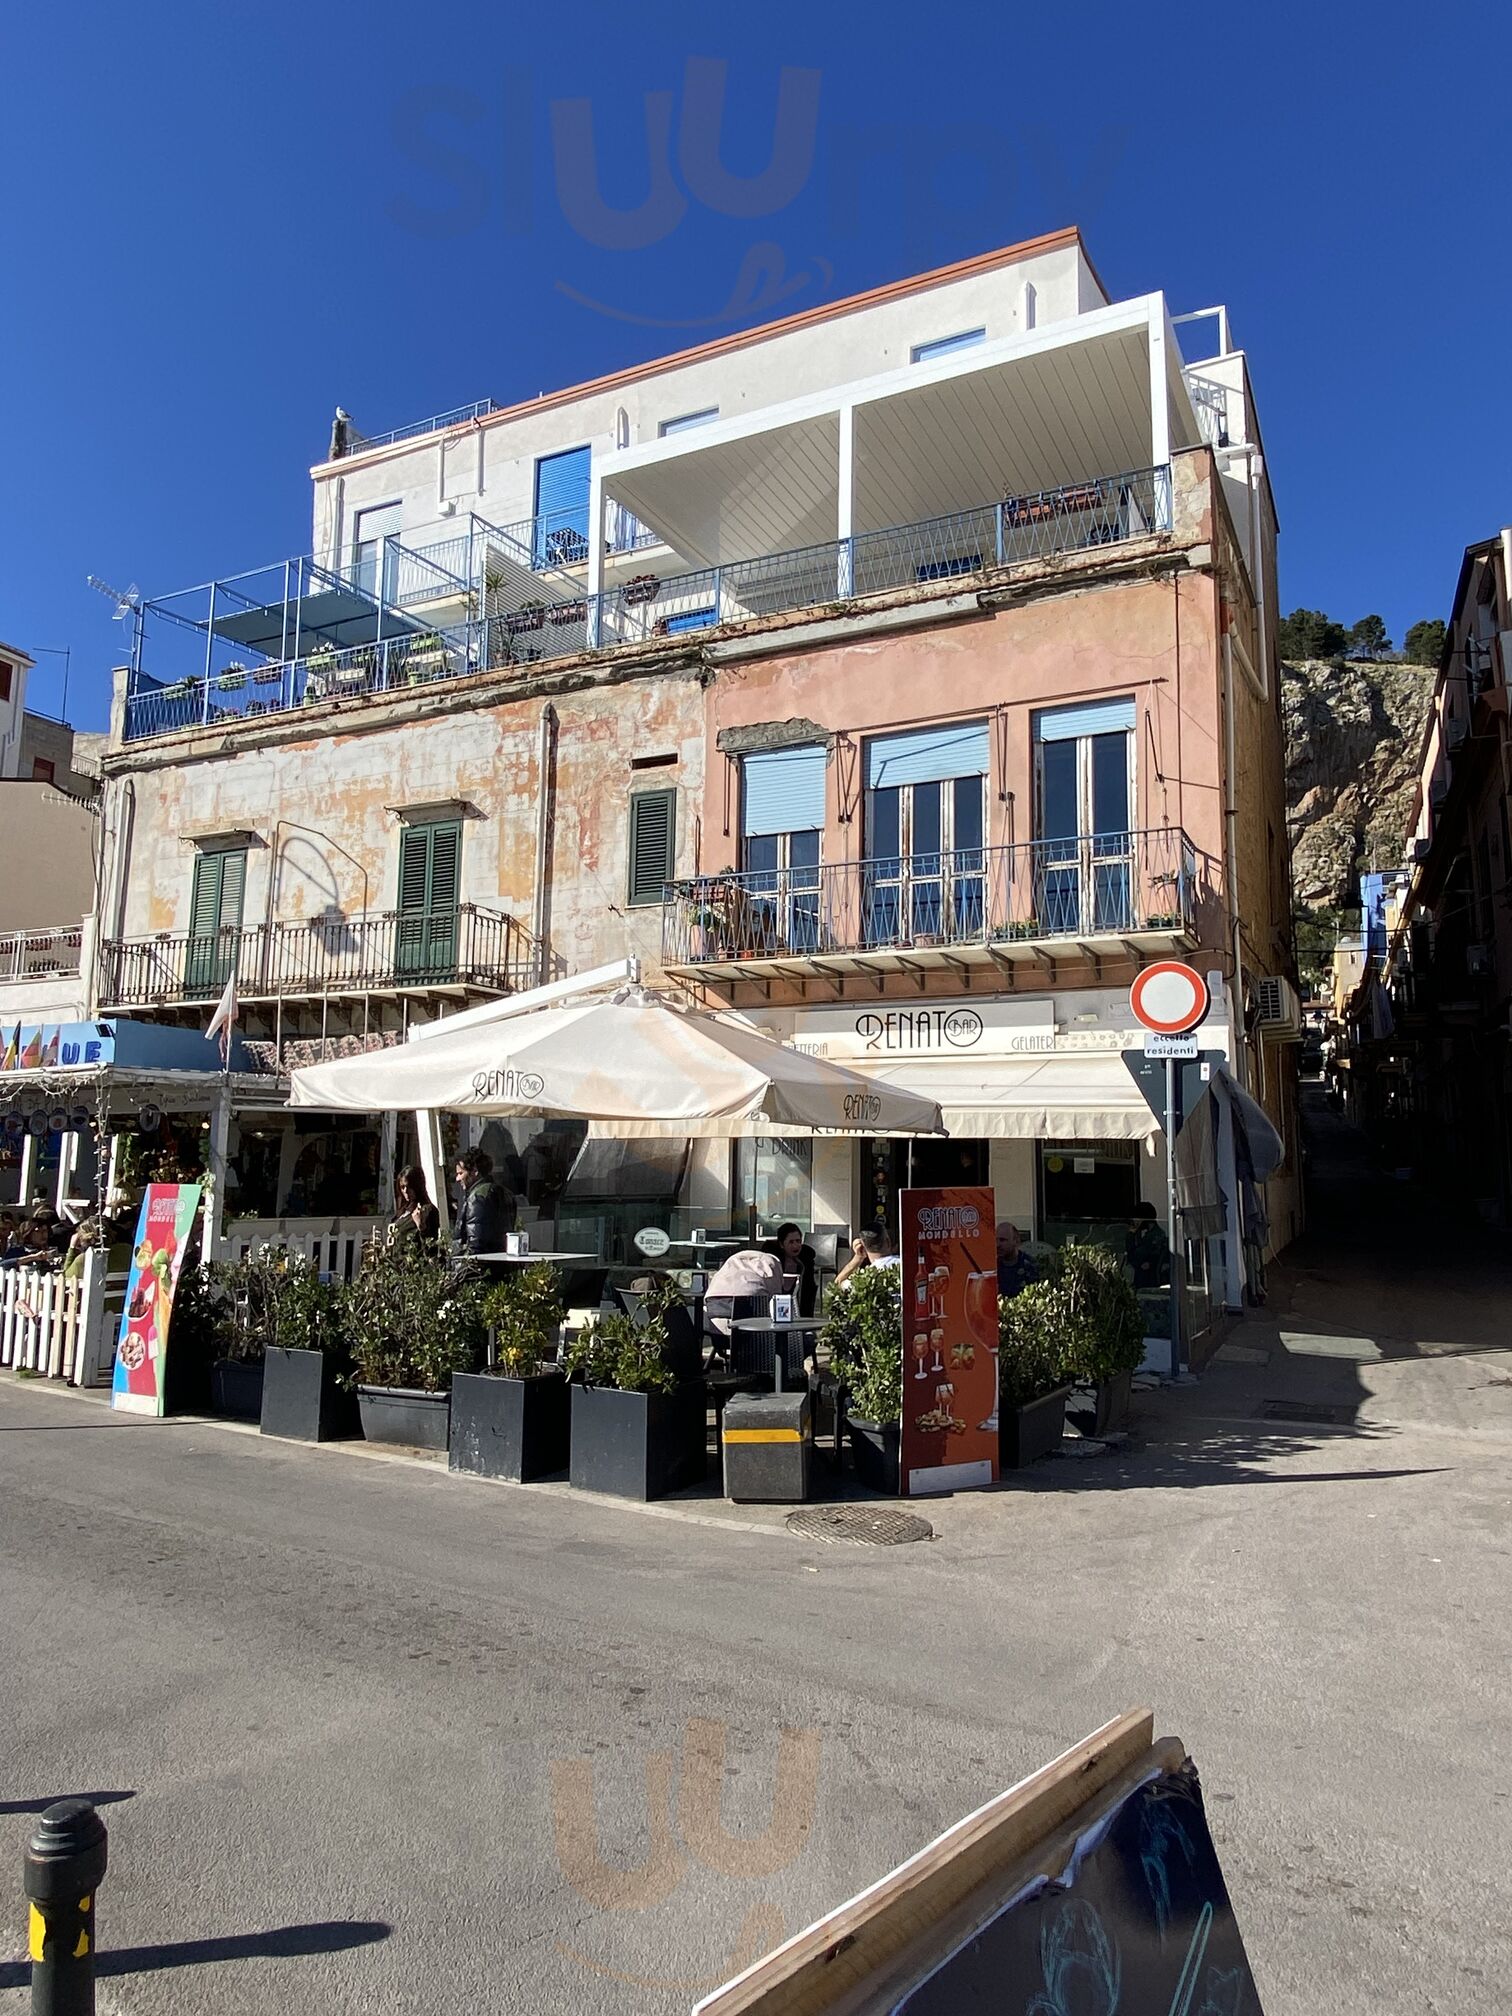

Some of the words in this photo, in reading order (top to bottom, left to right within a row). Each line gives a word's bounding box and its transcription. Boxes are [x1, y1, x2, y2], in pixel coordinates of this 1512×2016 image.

[855, 1008, 984, 1050] RENATO
[947, 1018, 978, 1037] BAR
[1147, 1046, 1194, 1055] residenti
[472, 1069, 545, 1099] RENATO
[917, 1205, 980, 1231] RENATO
[918, 1228, 980, 1240] MONDELLO
